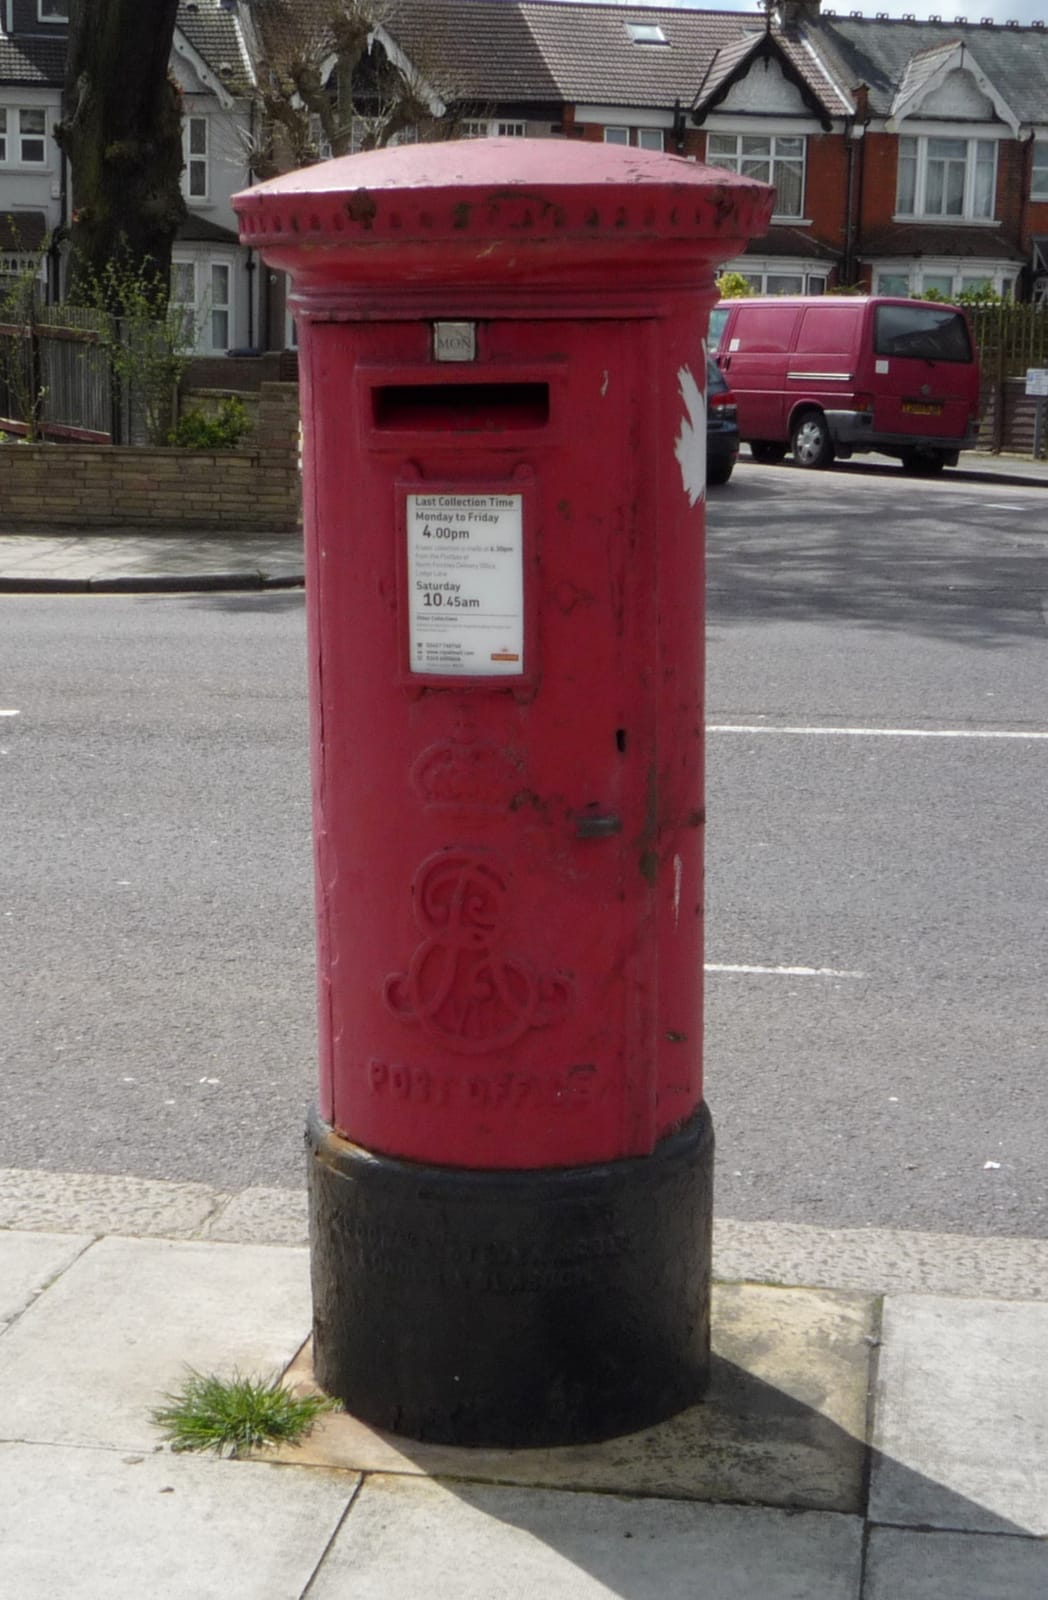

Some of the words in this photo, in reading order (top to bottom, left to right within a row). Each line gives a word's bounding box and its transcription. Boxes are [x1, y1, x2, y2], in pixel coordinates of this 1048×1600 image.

[438, 335, 472, 352] MON
[415, 497, 436, 507] Last
[439, 497, 487, 508] Collection
[490, 498, 514, 508] Time
[415, 512, 454, 523] Monday
[456, 513, 466, 522] to
[468, 513, 500, 524] Friday
[422, 524, 470, 541] 4.00pm
[416, 581, 461, 592] Saturday
[423, 592, 480, 608] 10.45am
